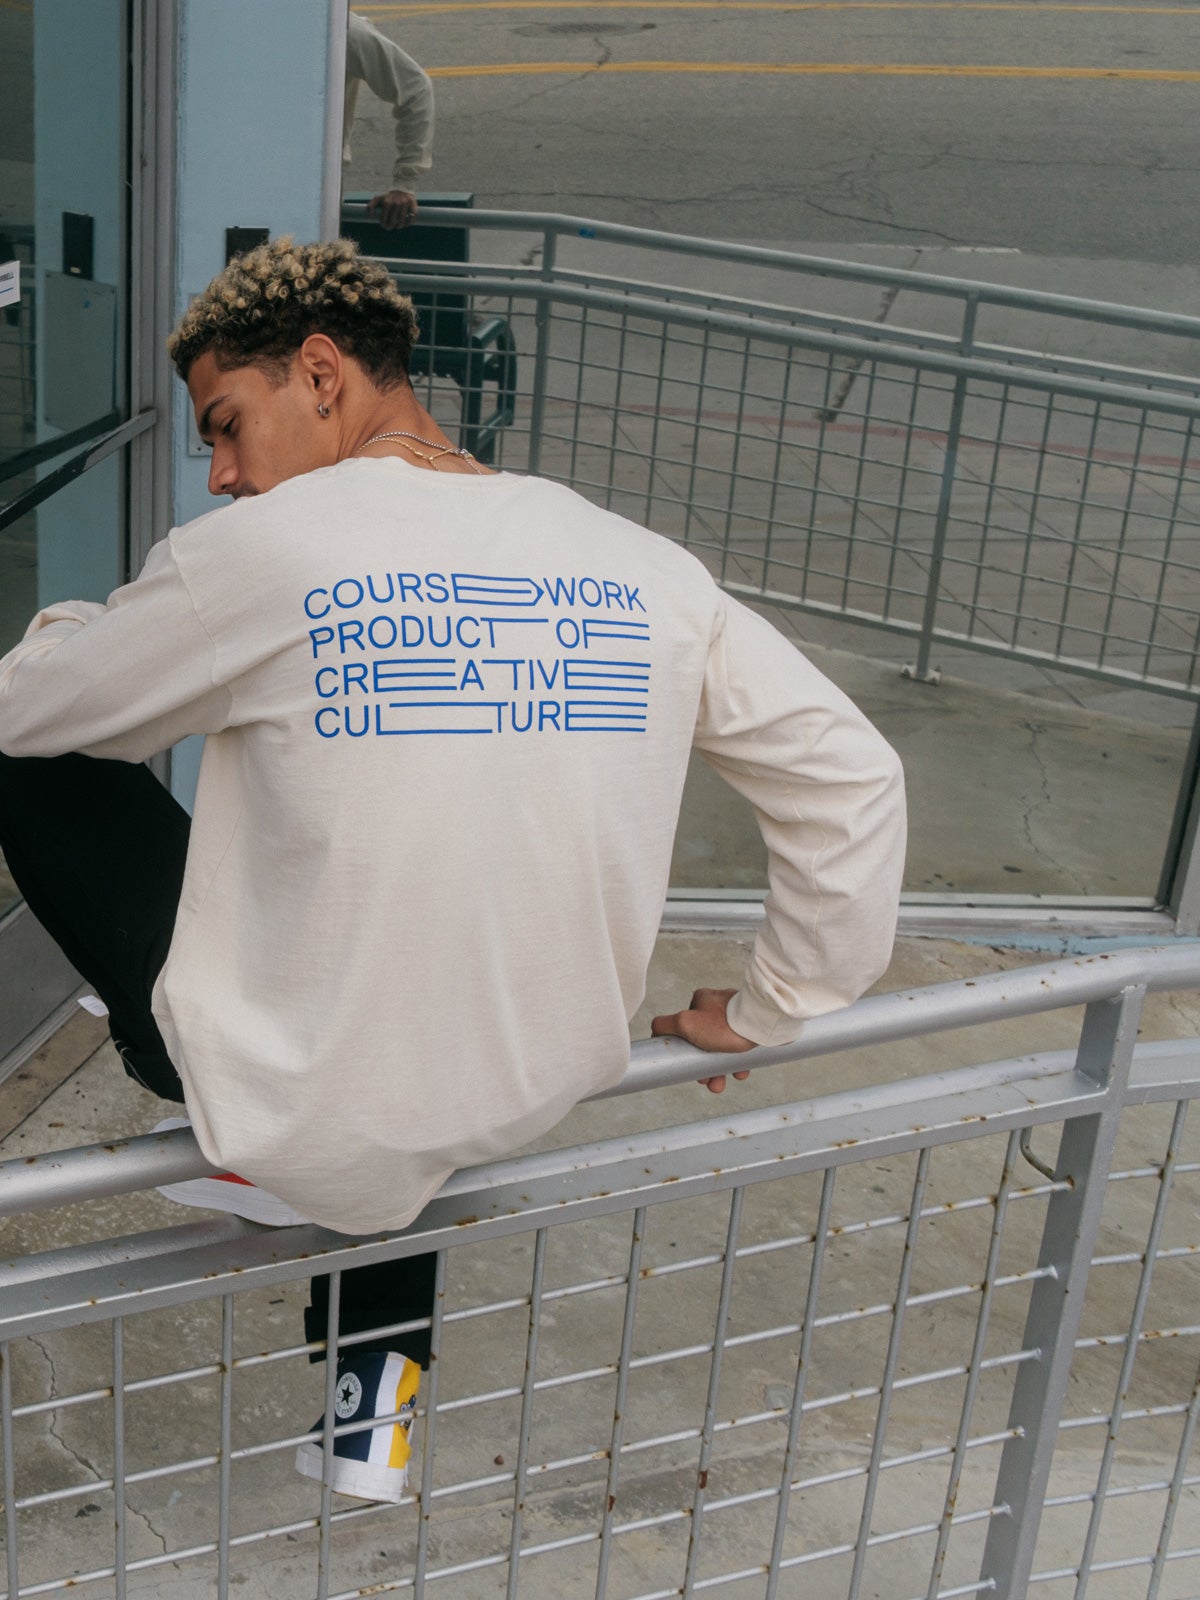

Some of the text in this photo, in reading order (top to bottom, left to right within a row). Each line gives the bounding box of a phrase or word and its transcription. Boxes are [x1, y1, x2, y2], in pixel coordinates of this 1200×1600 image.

[304, 572, 646, 620] COURSEWORK
[309, 615, 651, 659] PRODUCT OF
[315, 658, 651, 698] CREATIVE
[314, 700, 648, 739] CULTURE
